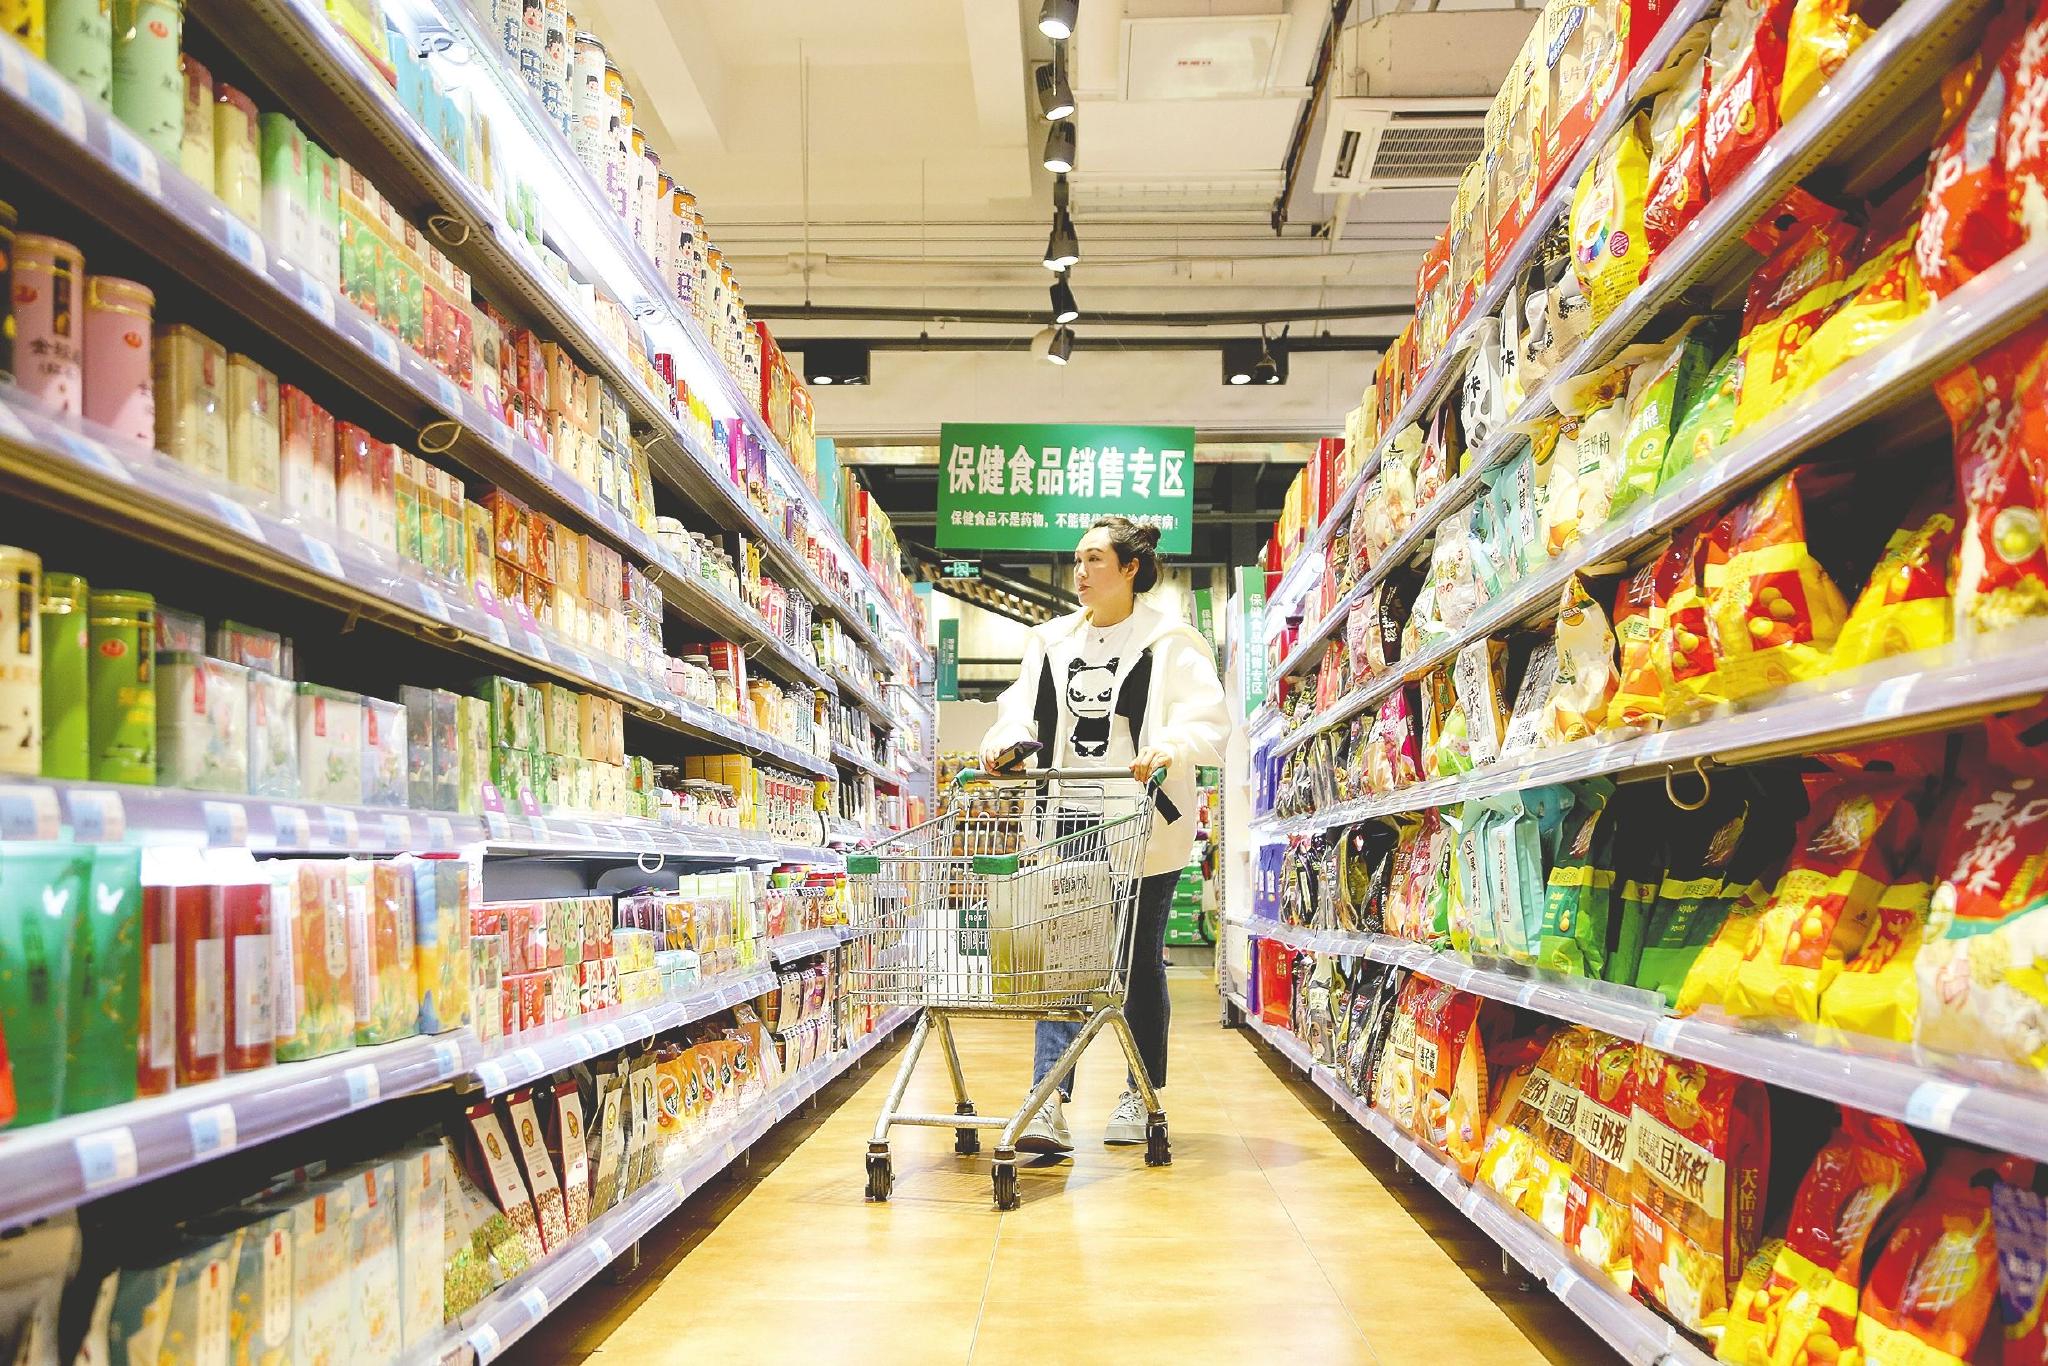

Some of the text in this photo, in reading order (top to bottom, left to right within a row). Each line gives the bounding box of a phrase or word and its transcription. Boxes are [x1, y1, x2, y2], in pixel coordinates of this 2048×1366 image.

[948, 443, 1186, 498] 保健食品销售专区
[1588, 1112, 1627, 1164] 豆奶粉
[1656, 1136, 1709, 1204] 豆奶粉
